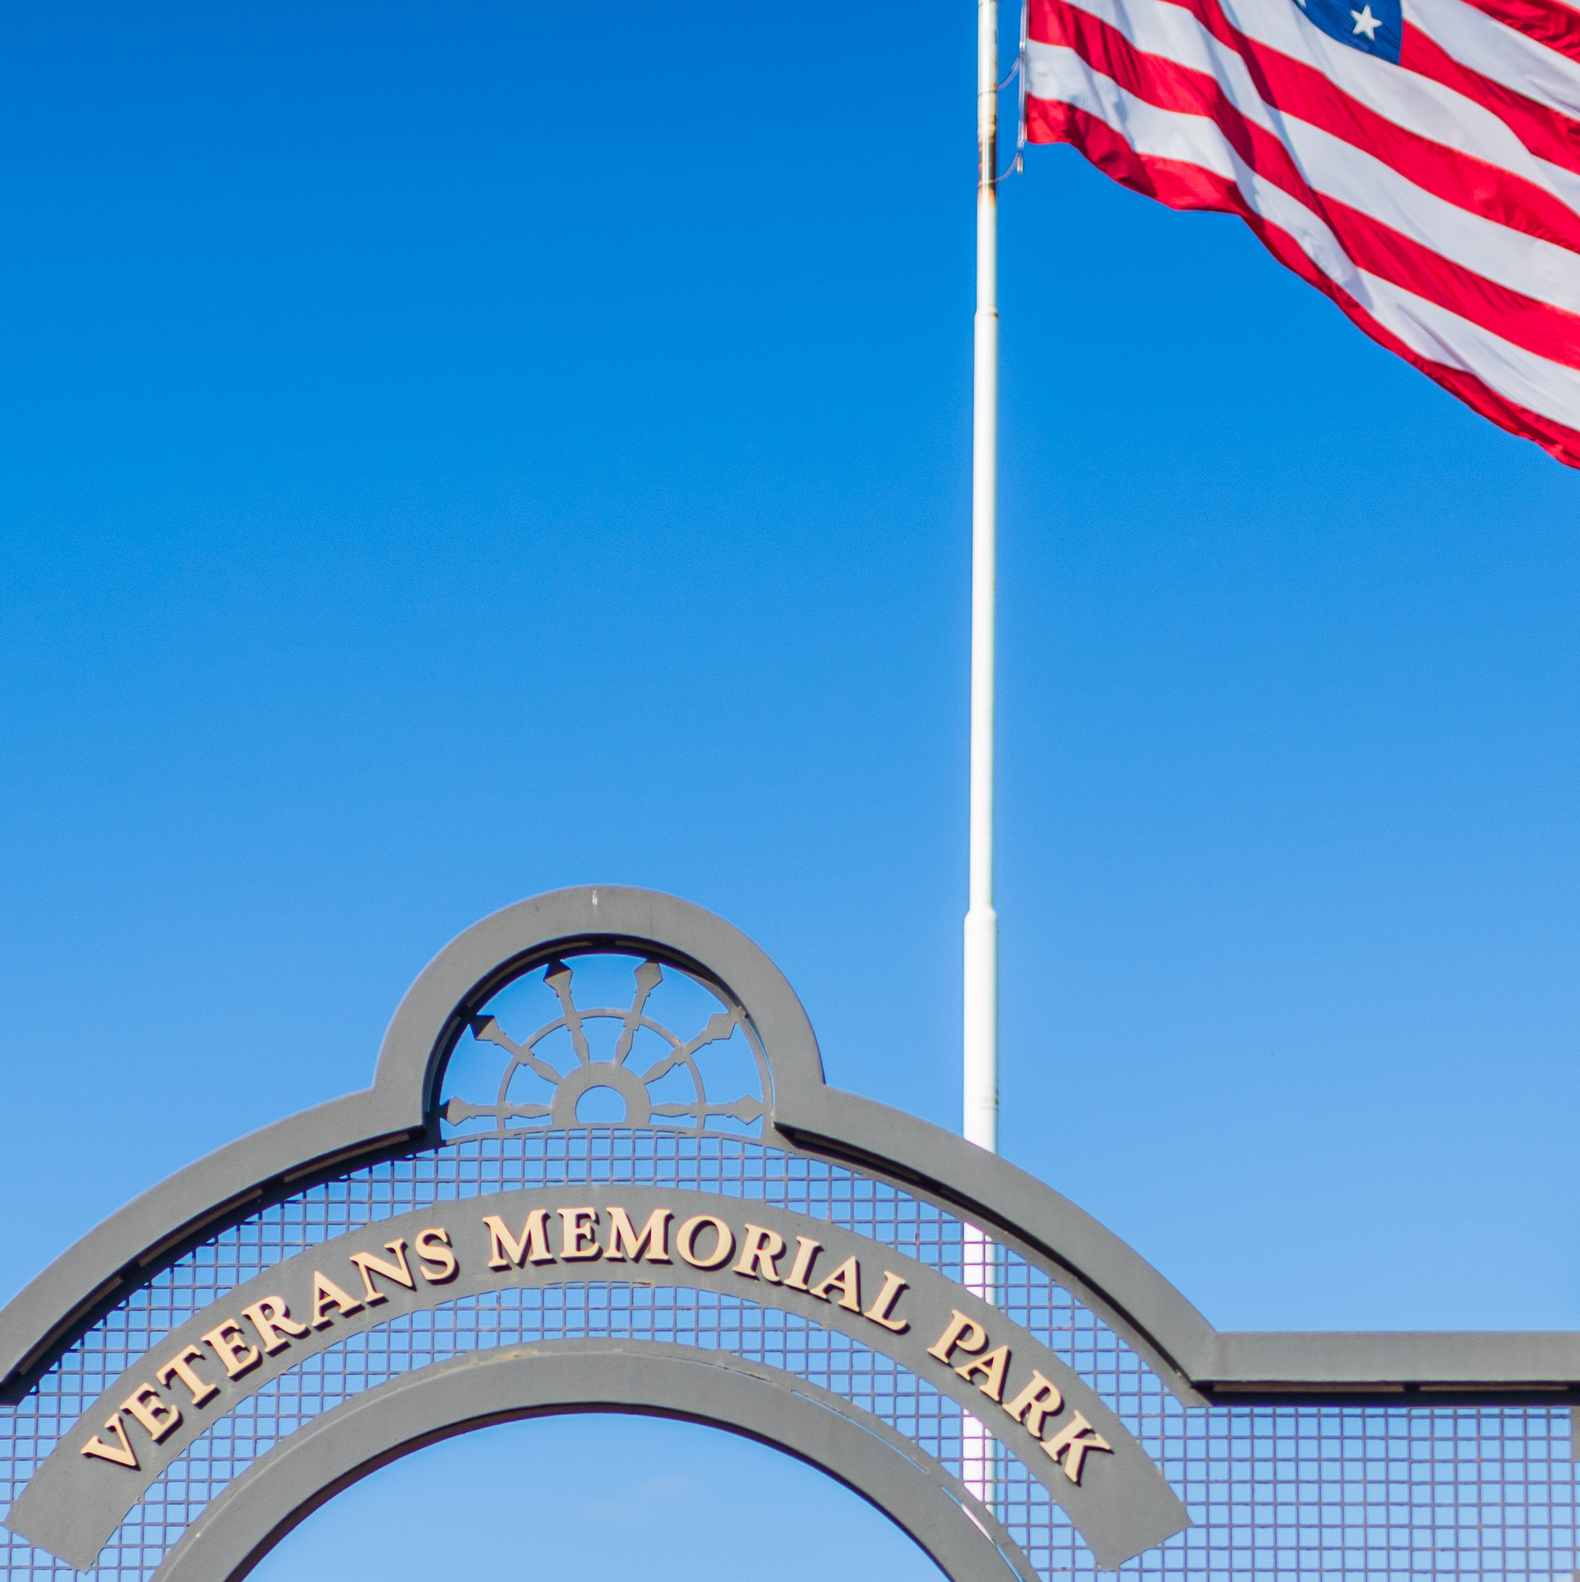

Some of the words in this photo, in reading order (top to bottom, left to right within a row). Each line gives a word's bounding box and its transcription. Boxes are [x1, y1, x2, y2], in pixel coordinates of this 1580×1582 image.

[80, 1227, 458, 1470] VETERANS
[482, 1206, 910, 1334] MEMORIAL
[927, 1309, 1113, 1487] PARK
